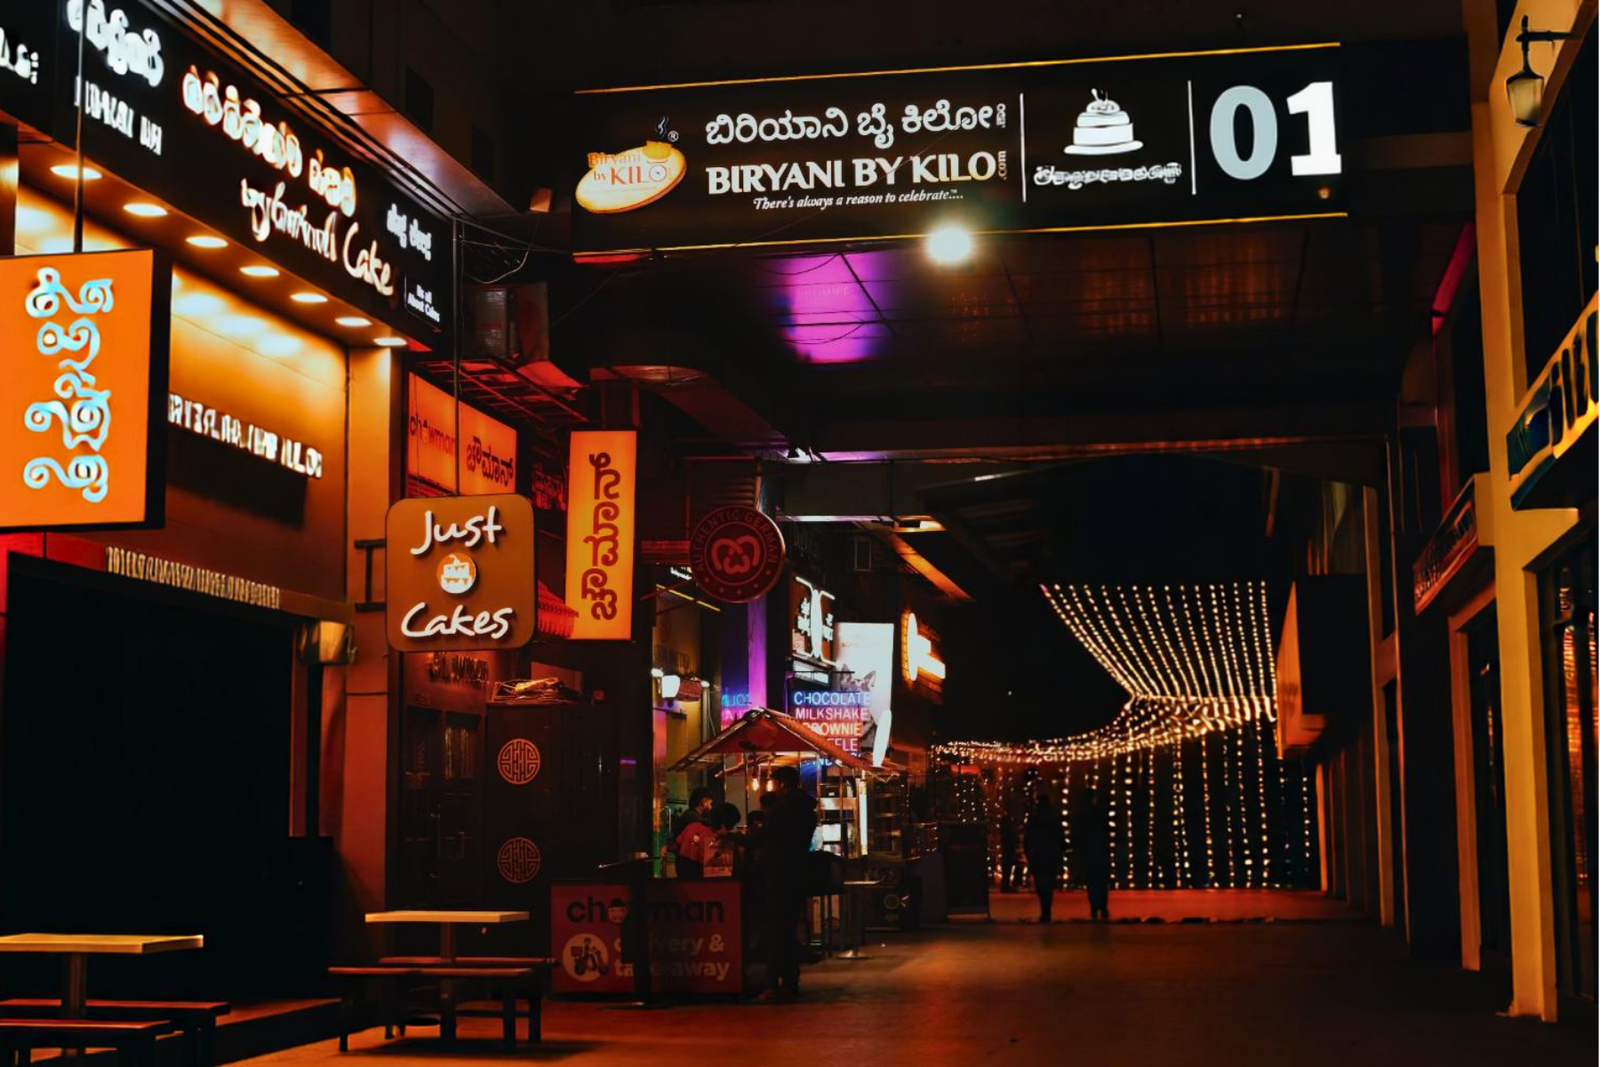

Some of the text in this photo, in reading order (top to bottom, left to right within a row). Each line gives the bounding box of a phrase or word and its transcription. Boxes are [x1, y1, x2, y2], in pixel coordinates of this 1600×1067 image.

[705, 99, 994, 149] ಬಿರಿಯಾನಿ ಬೈ ಕಿಲೋ
[1209, 80, 1343, 181] 01
[587, 149, 642, 168] Biryani
[593, 171, 608, 182] by
[705, 160, 847, 195] BIRYANI
[852, 156, 904, 187] BY
[909, 151, 997, 184] KILO
[752, 196, 795, 210] There's
[796, 195, 834, 211] always
[835, 197, 843, 205] a
[845, 193, 882, 206] reason
[885, 192, 896, 203] to
[466, 435, 514, 488] ಚೌಮಾನ್
[410, 505, 503, 556] Just
[581, 453, 621, 620] ಚೌಮಾನ್
[693, 508, 779, 572] AUTHENTIC GERMAN
[401, 602, 514, 640] Cakes
[793, 690, 871, 706] CHOCOLATE
[795, 707, 870, 721] MILKSHAKE
[708, 933, 726, 953] &
[613, 960, 731, 982] tae-away
